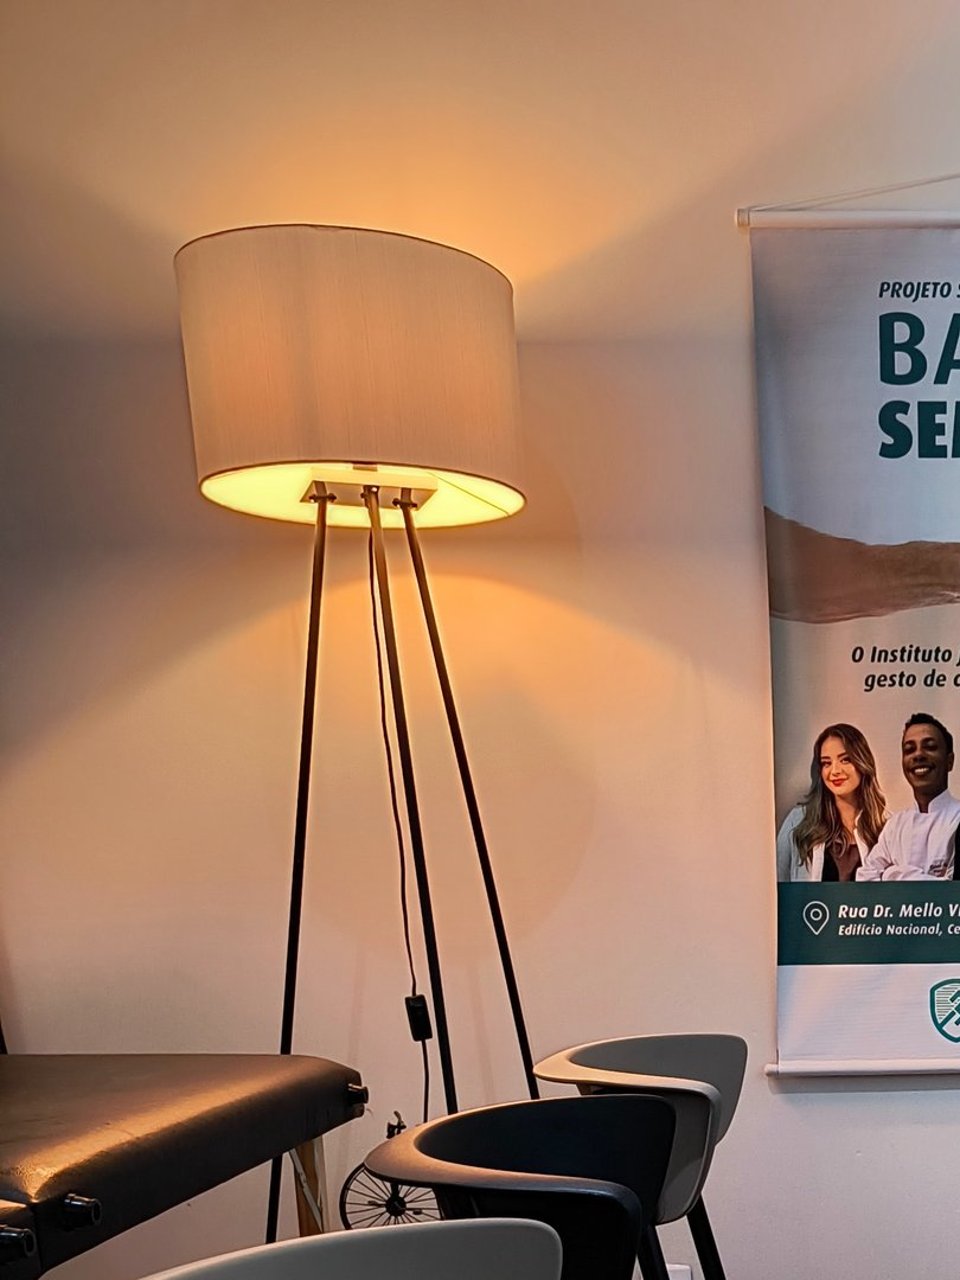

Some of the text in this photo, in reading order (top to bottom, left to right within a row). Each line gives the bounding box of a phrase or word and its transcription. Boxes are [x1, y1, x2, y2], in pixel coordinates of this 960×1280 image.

[879, 281, 952, 302] PROJETO
[851, 646, 864, 663] O
[870, 646, 952, 664] Instituto
[864, 669, 916, 692] gesto
[923, 669, 946, 687] de
[838, 904, 868, 918] Rua
[873, 904, 894, 918] Dr.
[899, 903, 943, 918] Mello
[838, 922, 882, 936] Edifício
[886, 922, 943, 937] Nacional,
